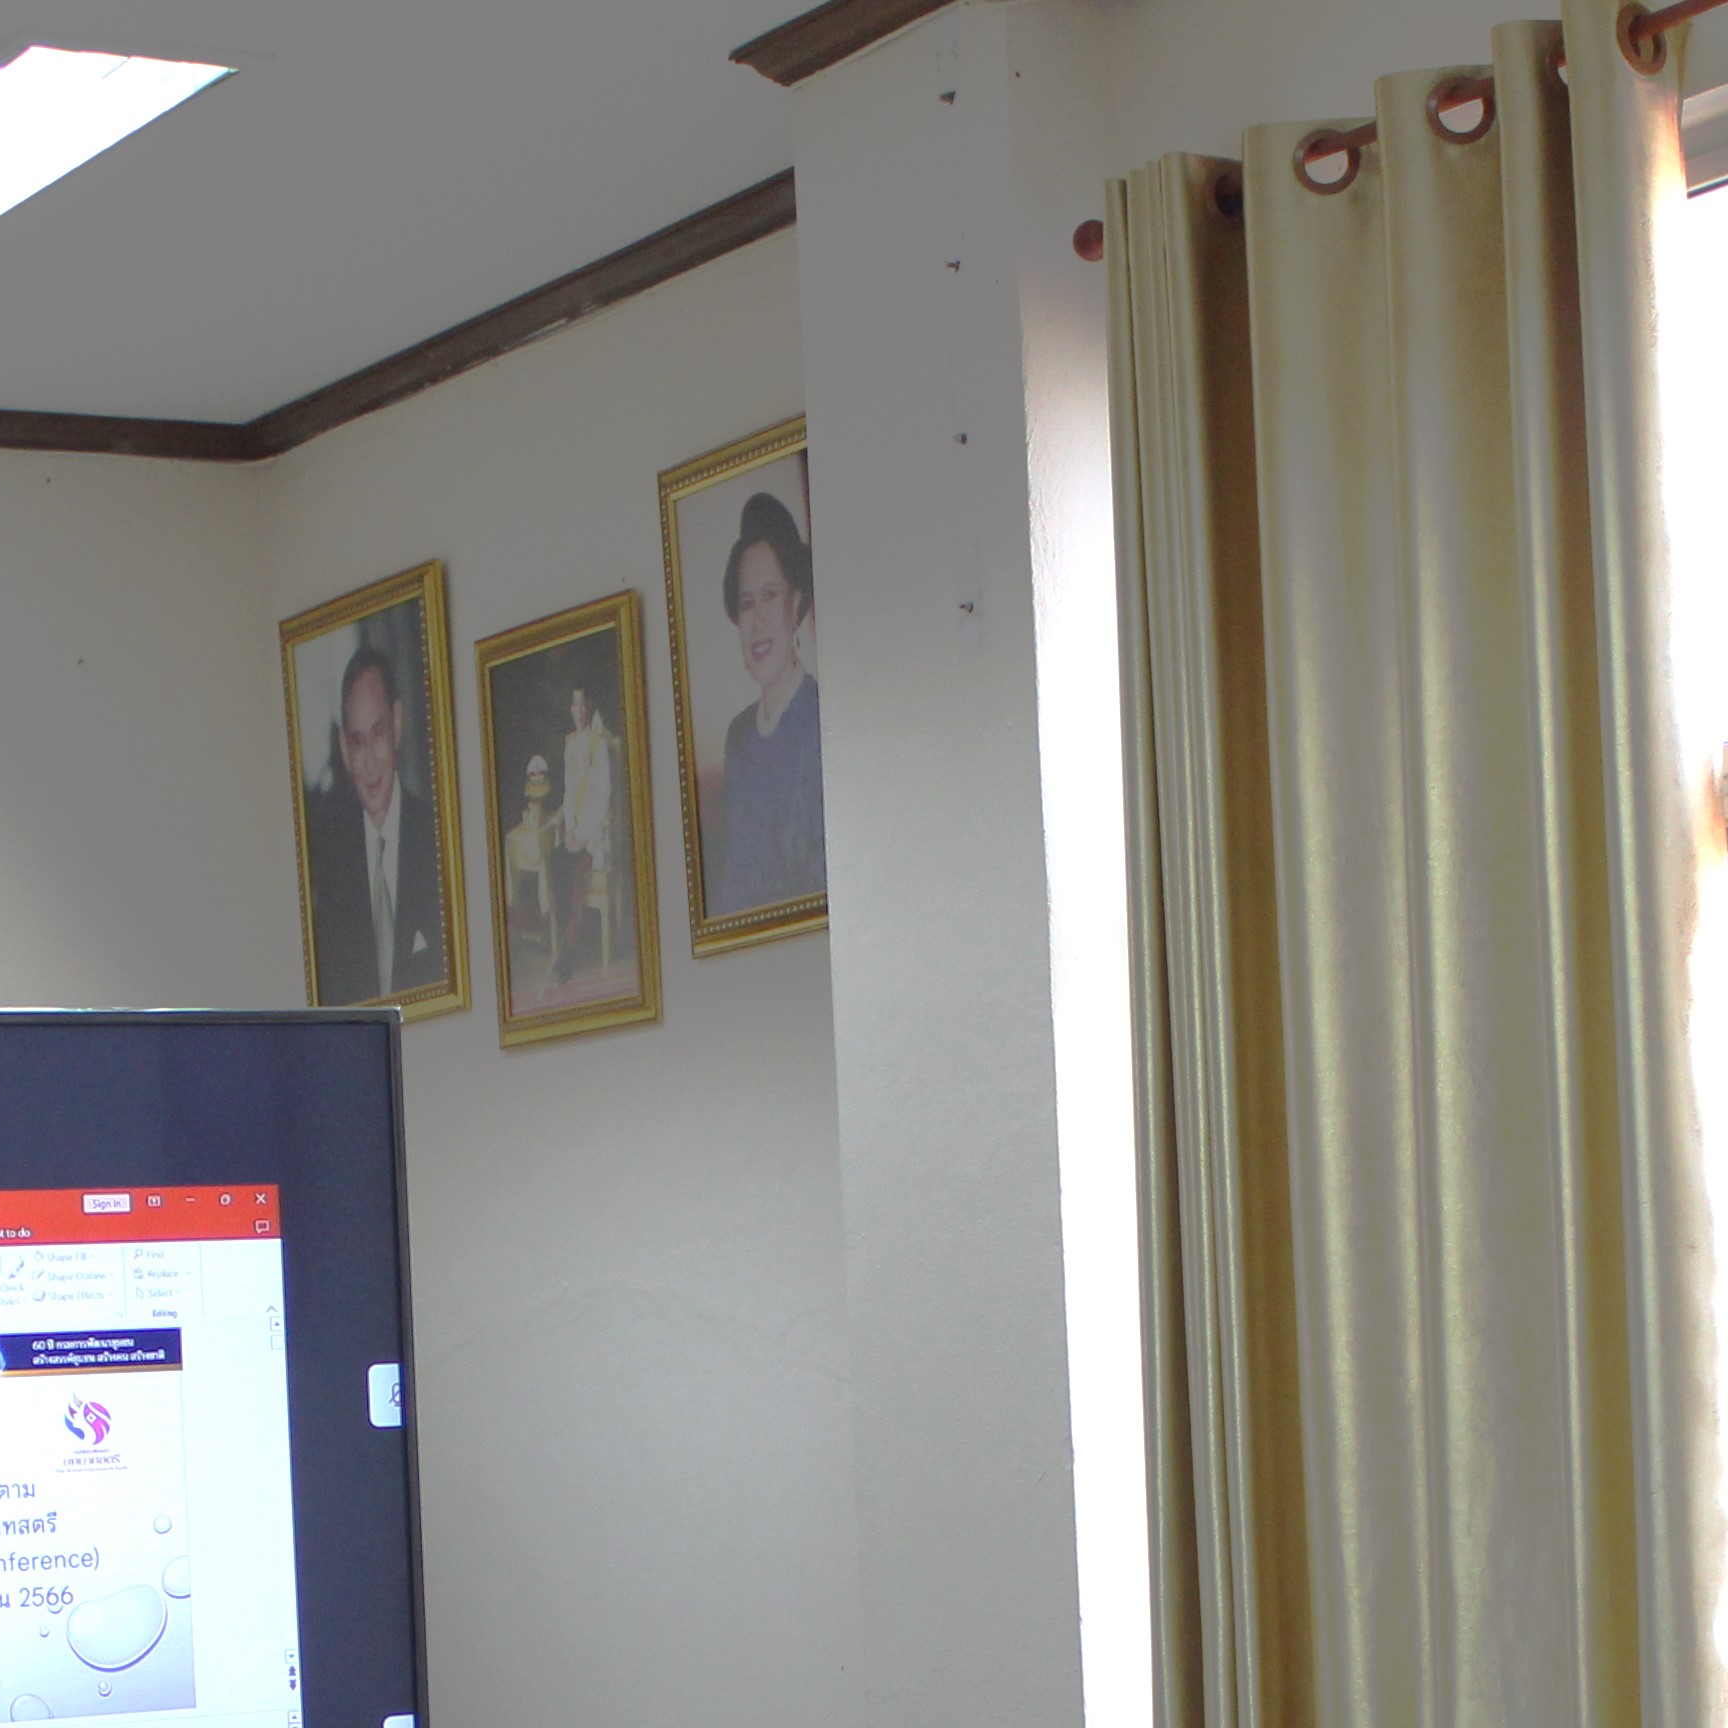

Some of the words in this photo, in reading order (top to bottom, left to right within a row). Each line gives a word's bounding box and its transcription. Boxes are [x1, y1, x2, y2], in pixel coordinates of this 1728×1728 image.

[92, 1199, 112, 1210] Sign
[47, 1252, 73, 1263] Shape
[48, 1271, 74, 1283] Shape
[148, 1268, 179, 1279] Replace
[48, 1290, 75, 1302] Shape
[148, 1287, 174, 1298] Select
[152, 1309, 178, 1319] Editing
[32, 1340, 46, 1351] 60
[19, 1584, 75, 1608] 2566
